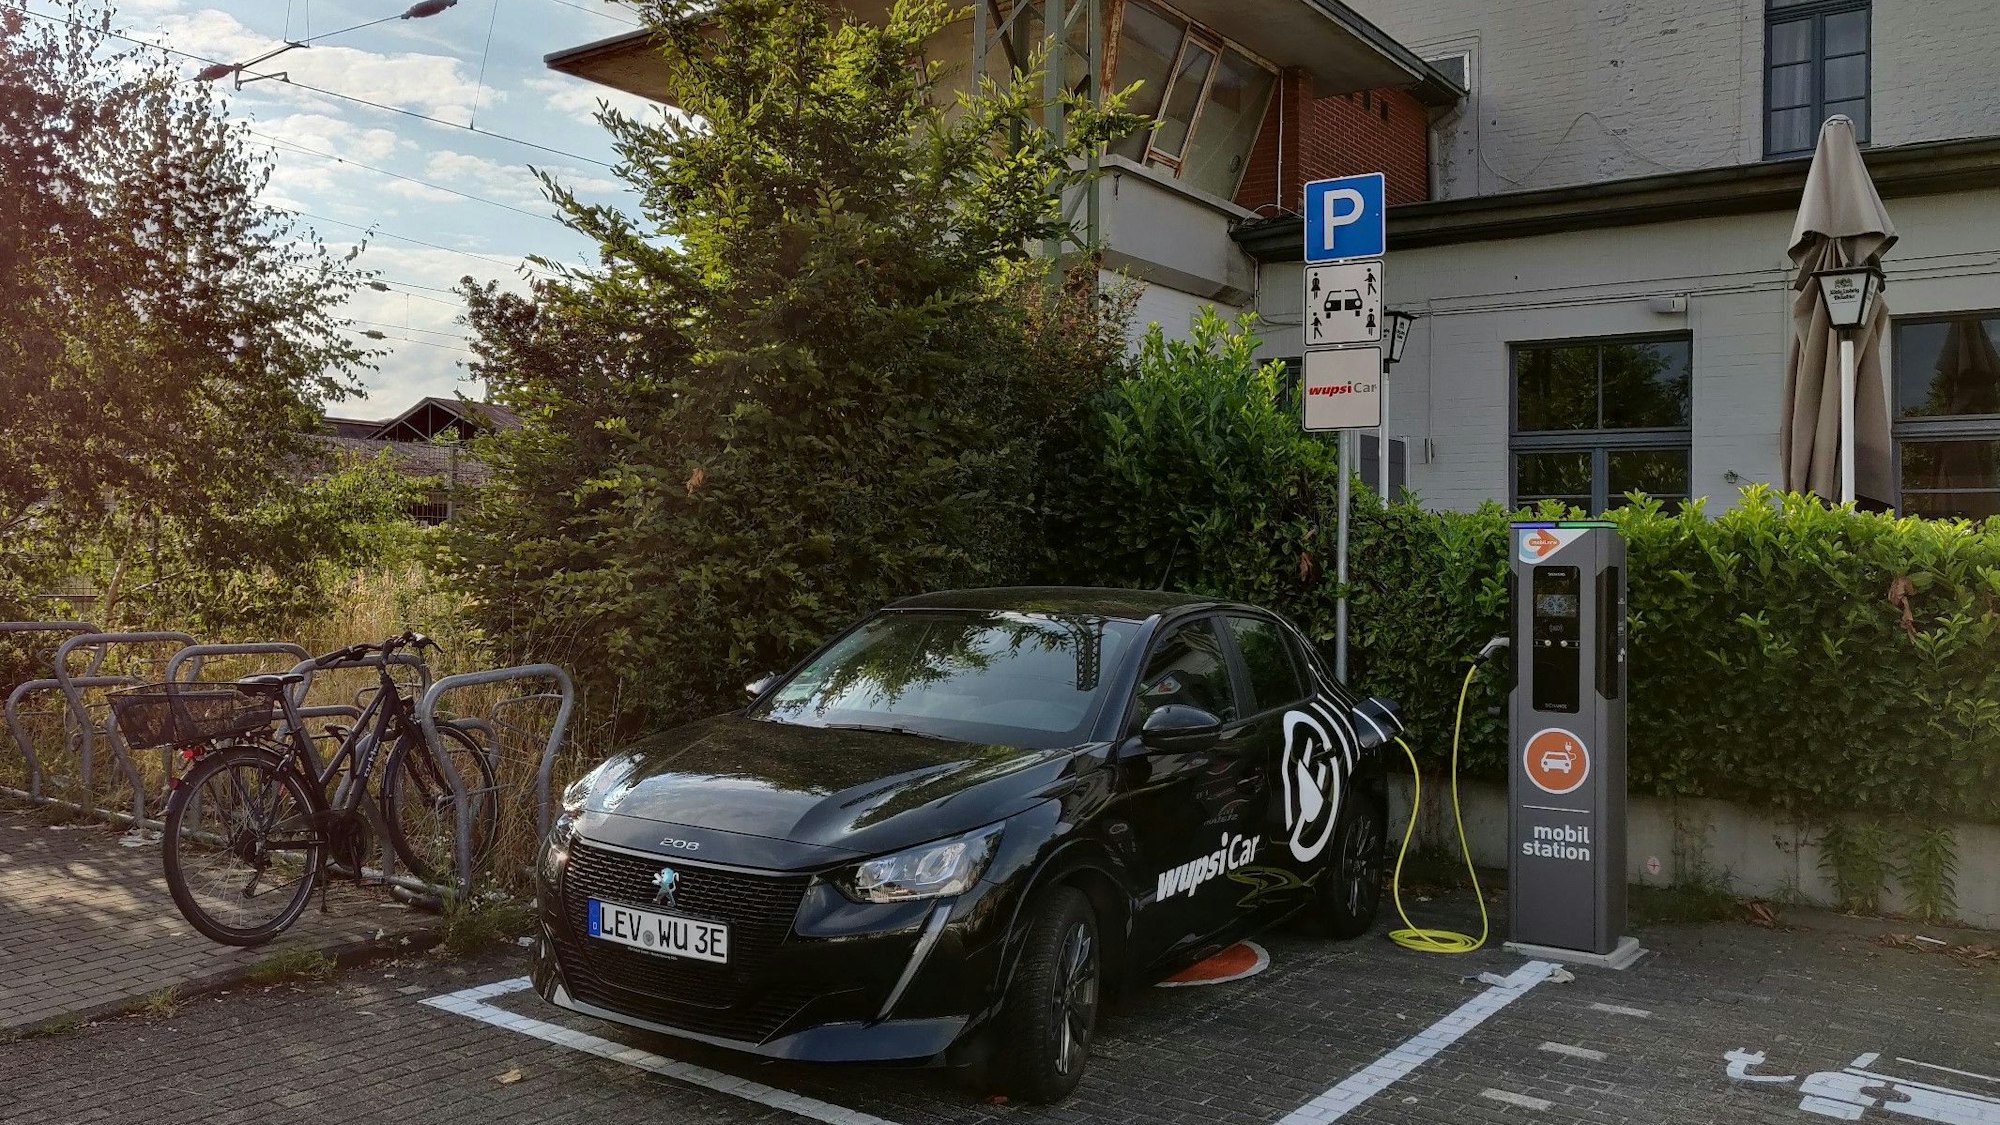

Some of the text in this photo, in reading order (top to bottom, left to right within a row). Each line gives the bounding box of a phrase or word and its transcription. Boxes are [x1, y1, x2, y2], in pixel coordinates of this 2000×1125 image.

[1323, 188, 1365, 250] P
[660, 837, 700, 851] 208
[1522, 841, 1590, 861] station
[1533, 824, 1590, 844] mobil
[1155, 831, 1260, 902] wupsiCar
[601, 906, 642, 942] LEV
[658, 918, 688, 951] WU
[694, 925, 726, 958] 3E
